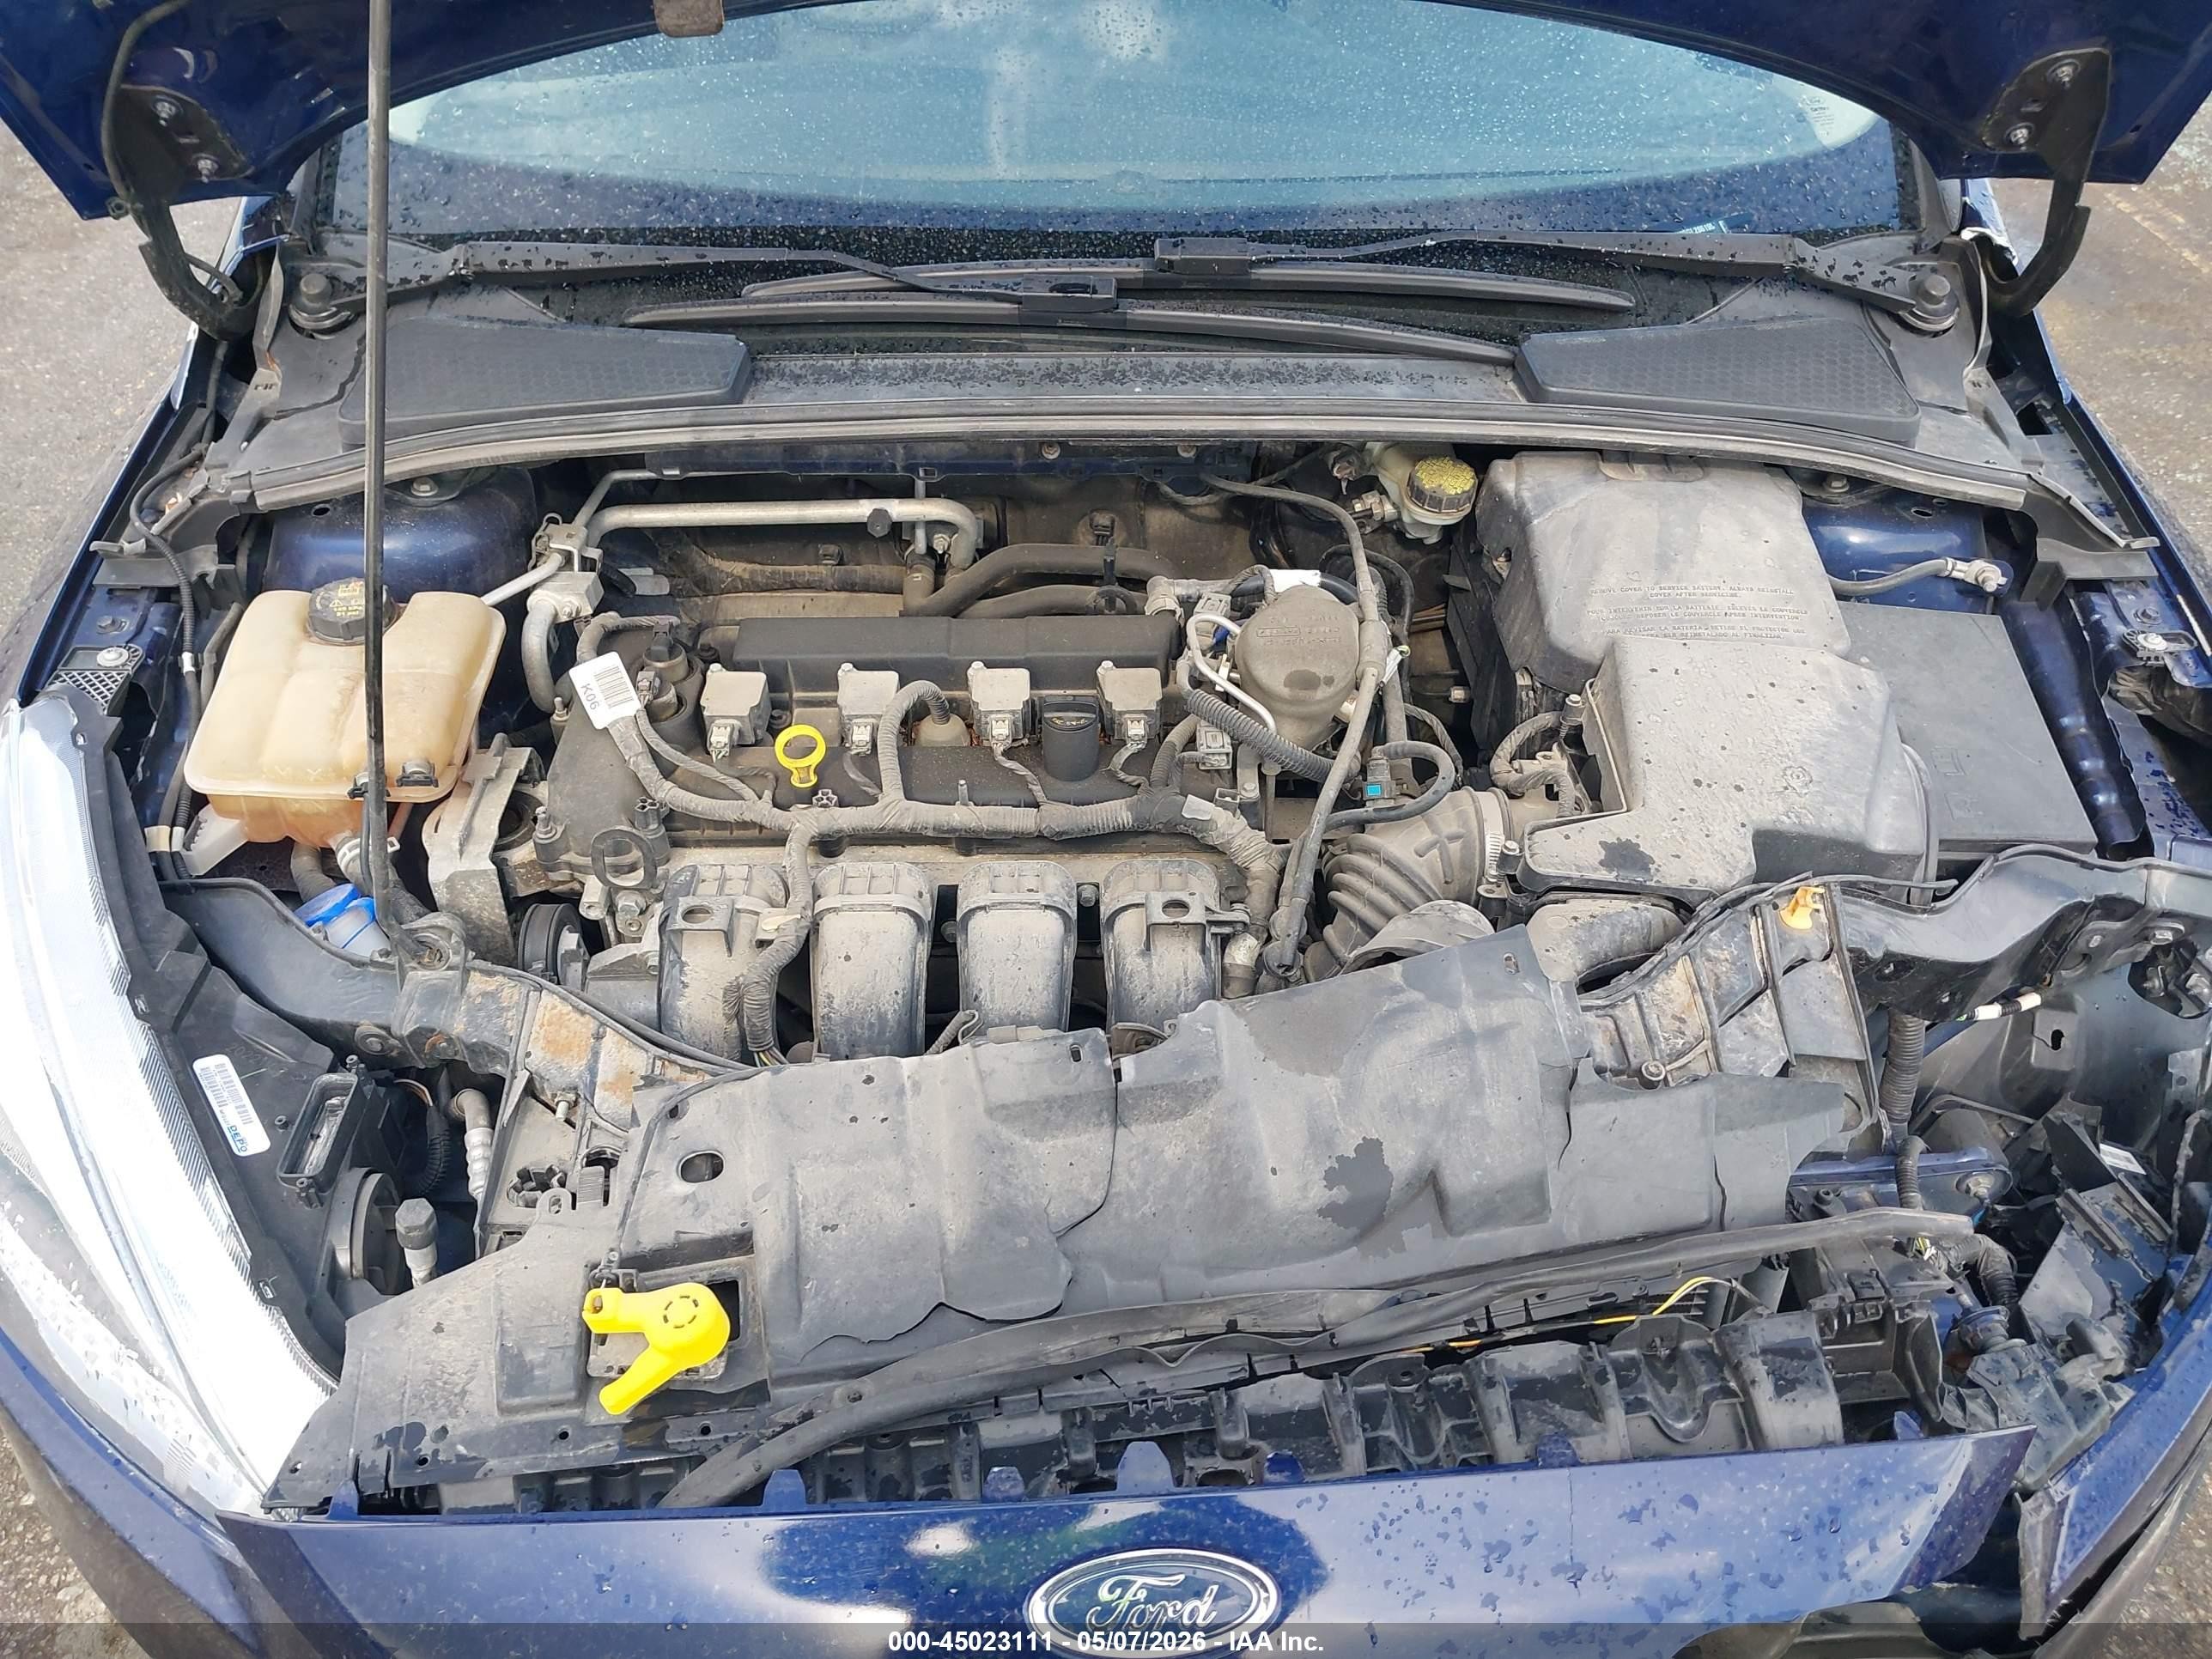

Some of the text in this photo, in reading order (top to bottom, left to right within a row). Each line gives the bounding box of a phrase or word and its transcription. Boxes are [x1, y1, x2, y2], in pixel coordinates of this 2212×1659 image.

[1758, 586, 1794, 595] REINSTALL
[1608, 605, 1653, 614] INTERVENIR
[580, 683, 600, 711] K06
[230, 1125, 248, 1152] DEPO
[1085, 1573, 1219, 1632] Ford
